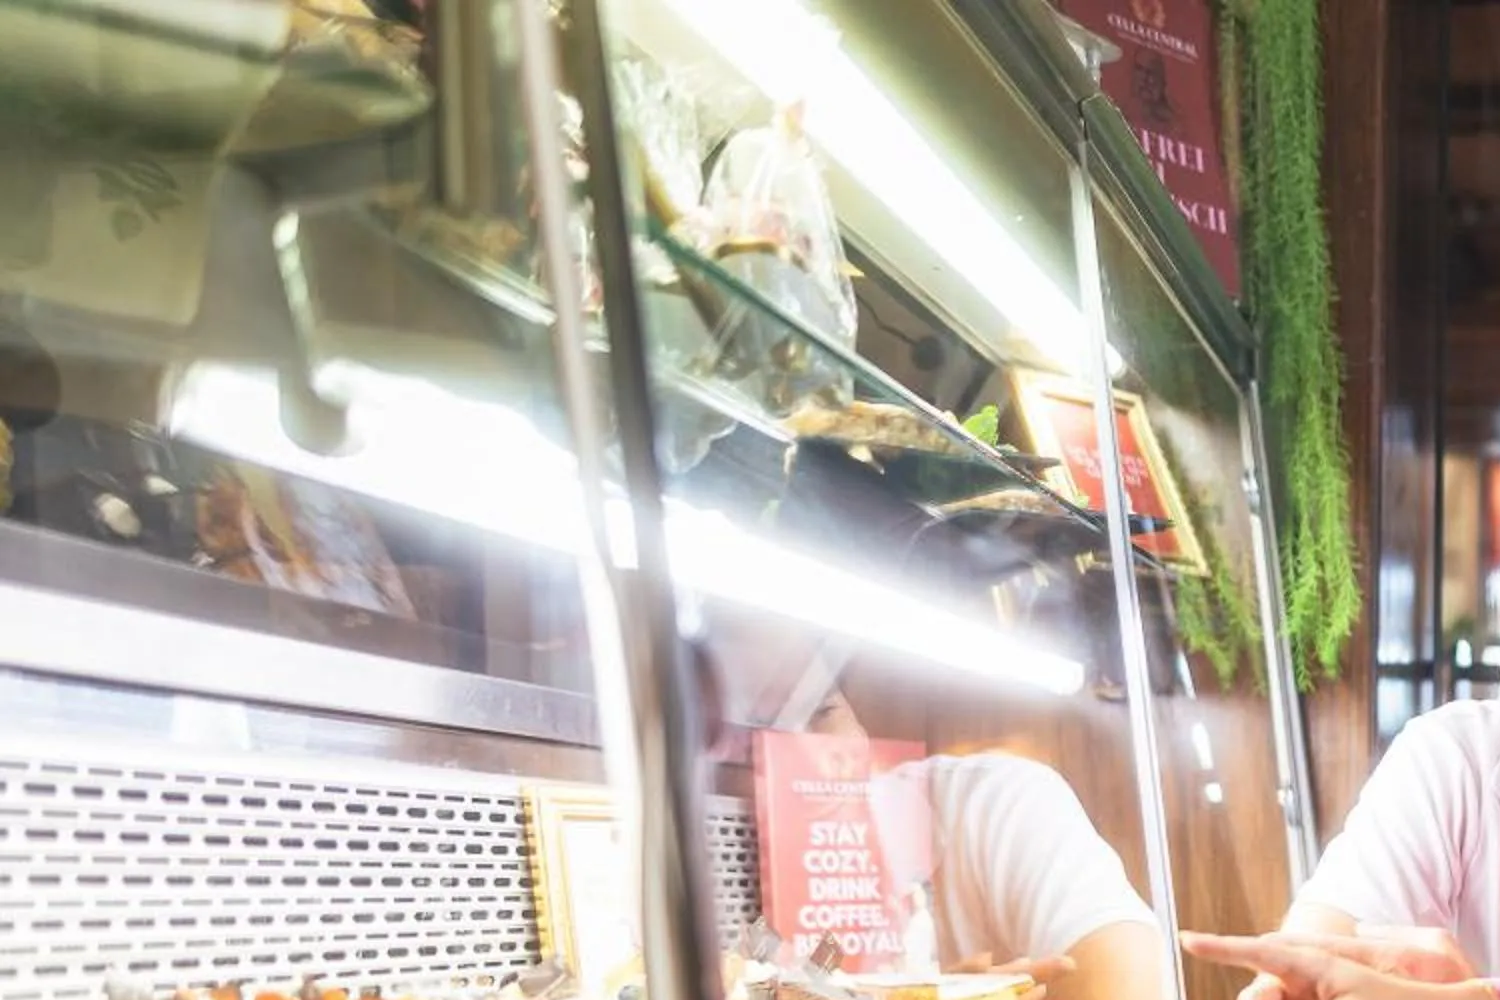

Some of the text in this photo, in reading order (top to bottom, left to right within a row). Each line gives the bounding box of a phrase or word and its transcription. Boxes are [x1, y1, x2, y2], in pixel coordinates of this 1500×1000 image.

[810, 821, 867, 845] STAY
[803, 848, 879, 875] COZY.
[809, 876, 881, 900] DRINK
[798, 904, 890, 930] COFFEE.
[836, 930, 904, 956] OYAL
